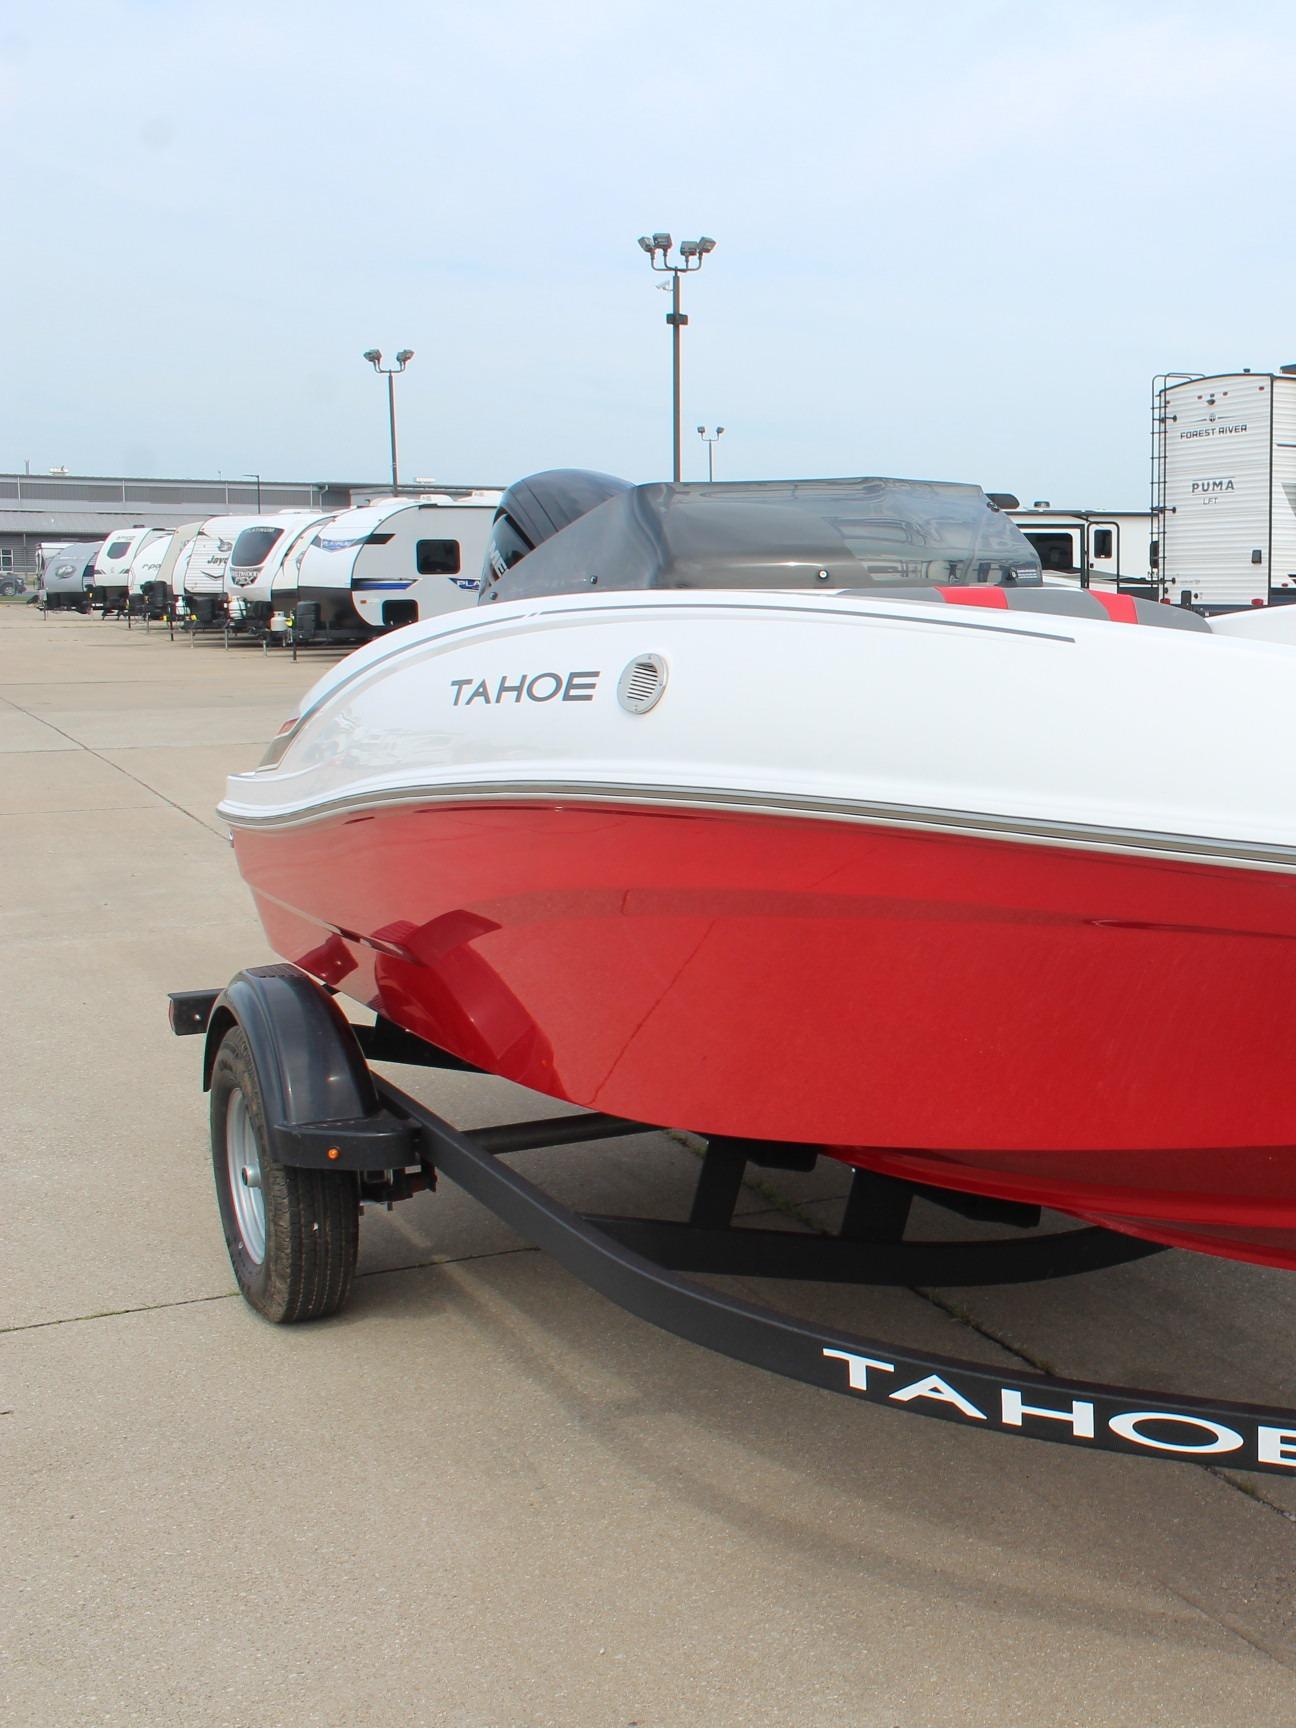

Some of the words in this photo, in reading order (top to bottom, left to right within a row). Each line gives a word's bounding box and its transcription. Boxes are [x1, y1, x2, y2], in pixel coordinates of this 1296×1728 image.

[1180, 427, 1216, 440] FOREST
[1218, 424, 1248, 435] RIVER
[1191, 479, 1235, 494] PUMA
[450, 670, 601, 706] TAHOE
